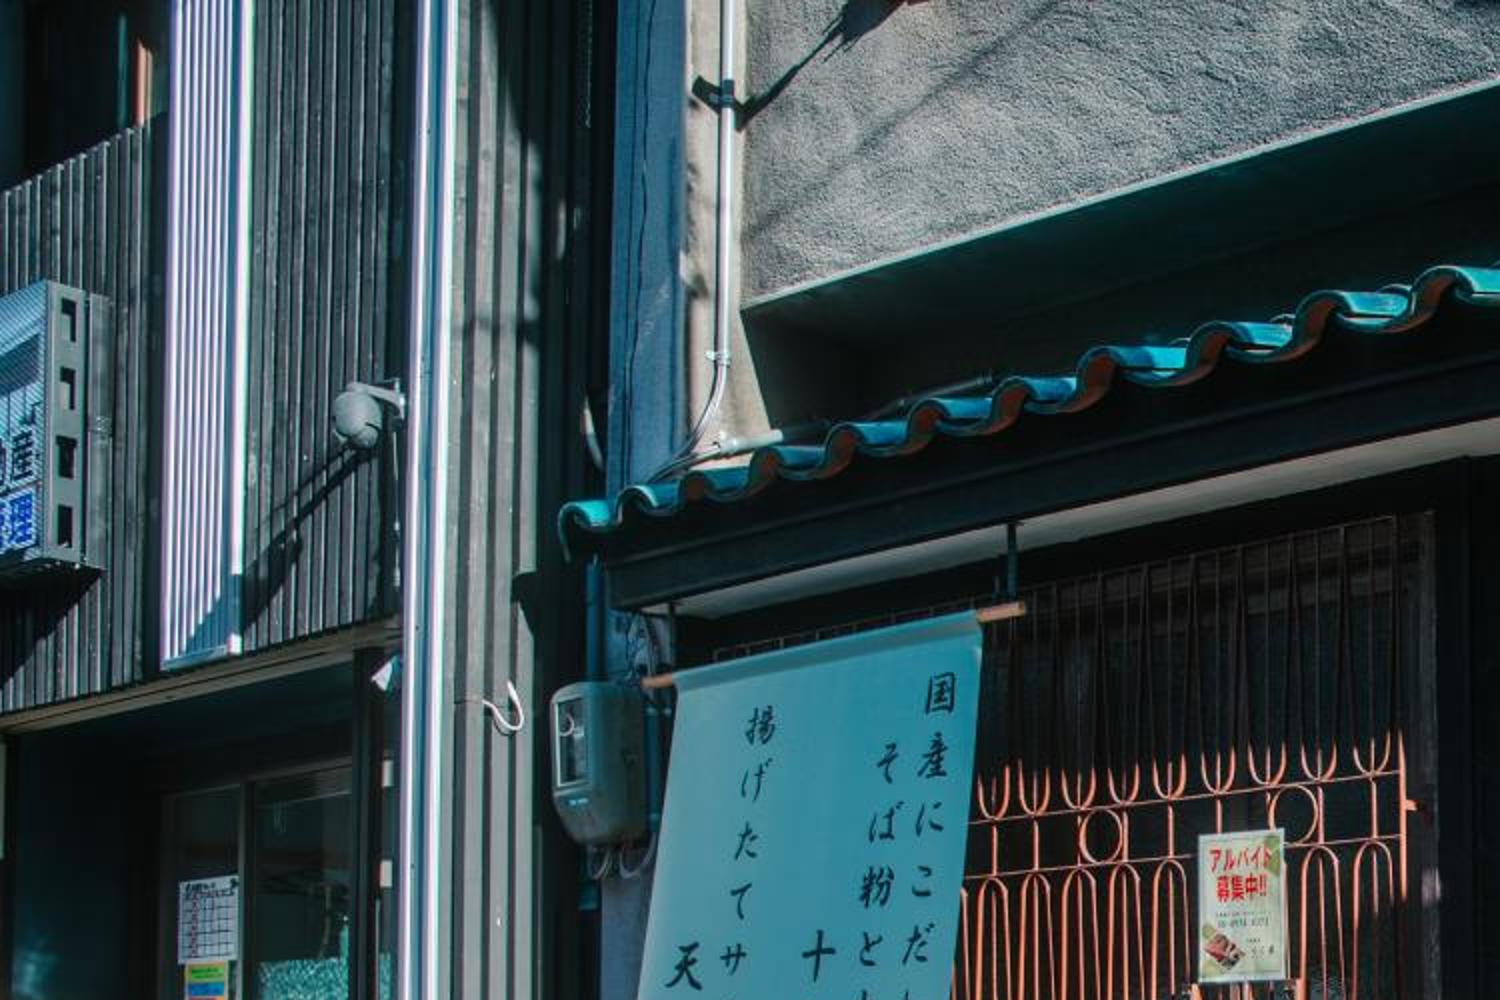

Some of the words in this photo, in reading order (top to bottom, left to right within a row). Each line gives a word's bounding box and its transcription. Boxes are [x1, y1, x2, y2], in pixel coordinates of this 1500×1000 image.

[1209, 847, 1271, 872] アルバイト
